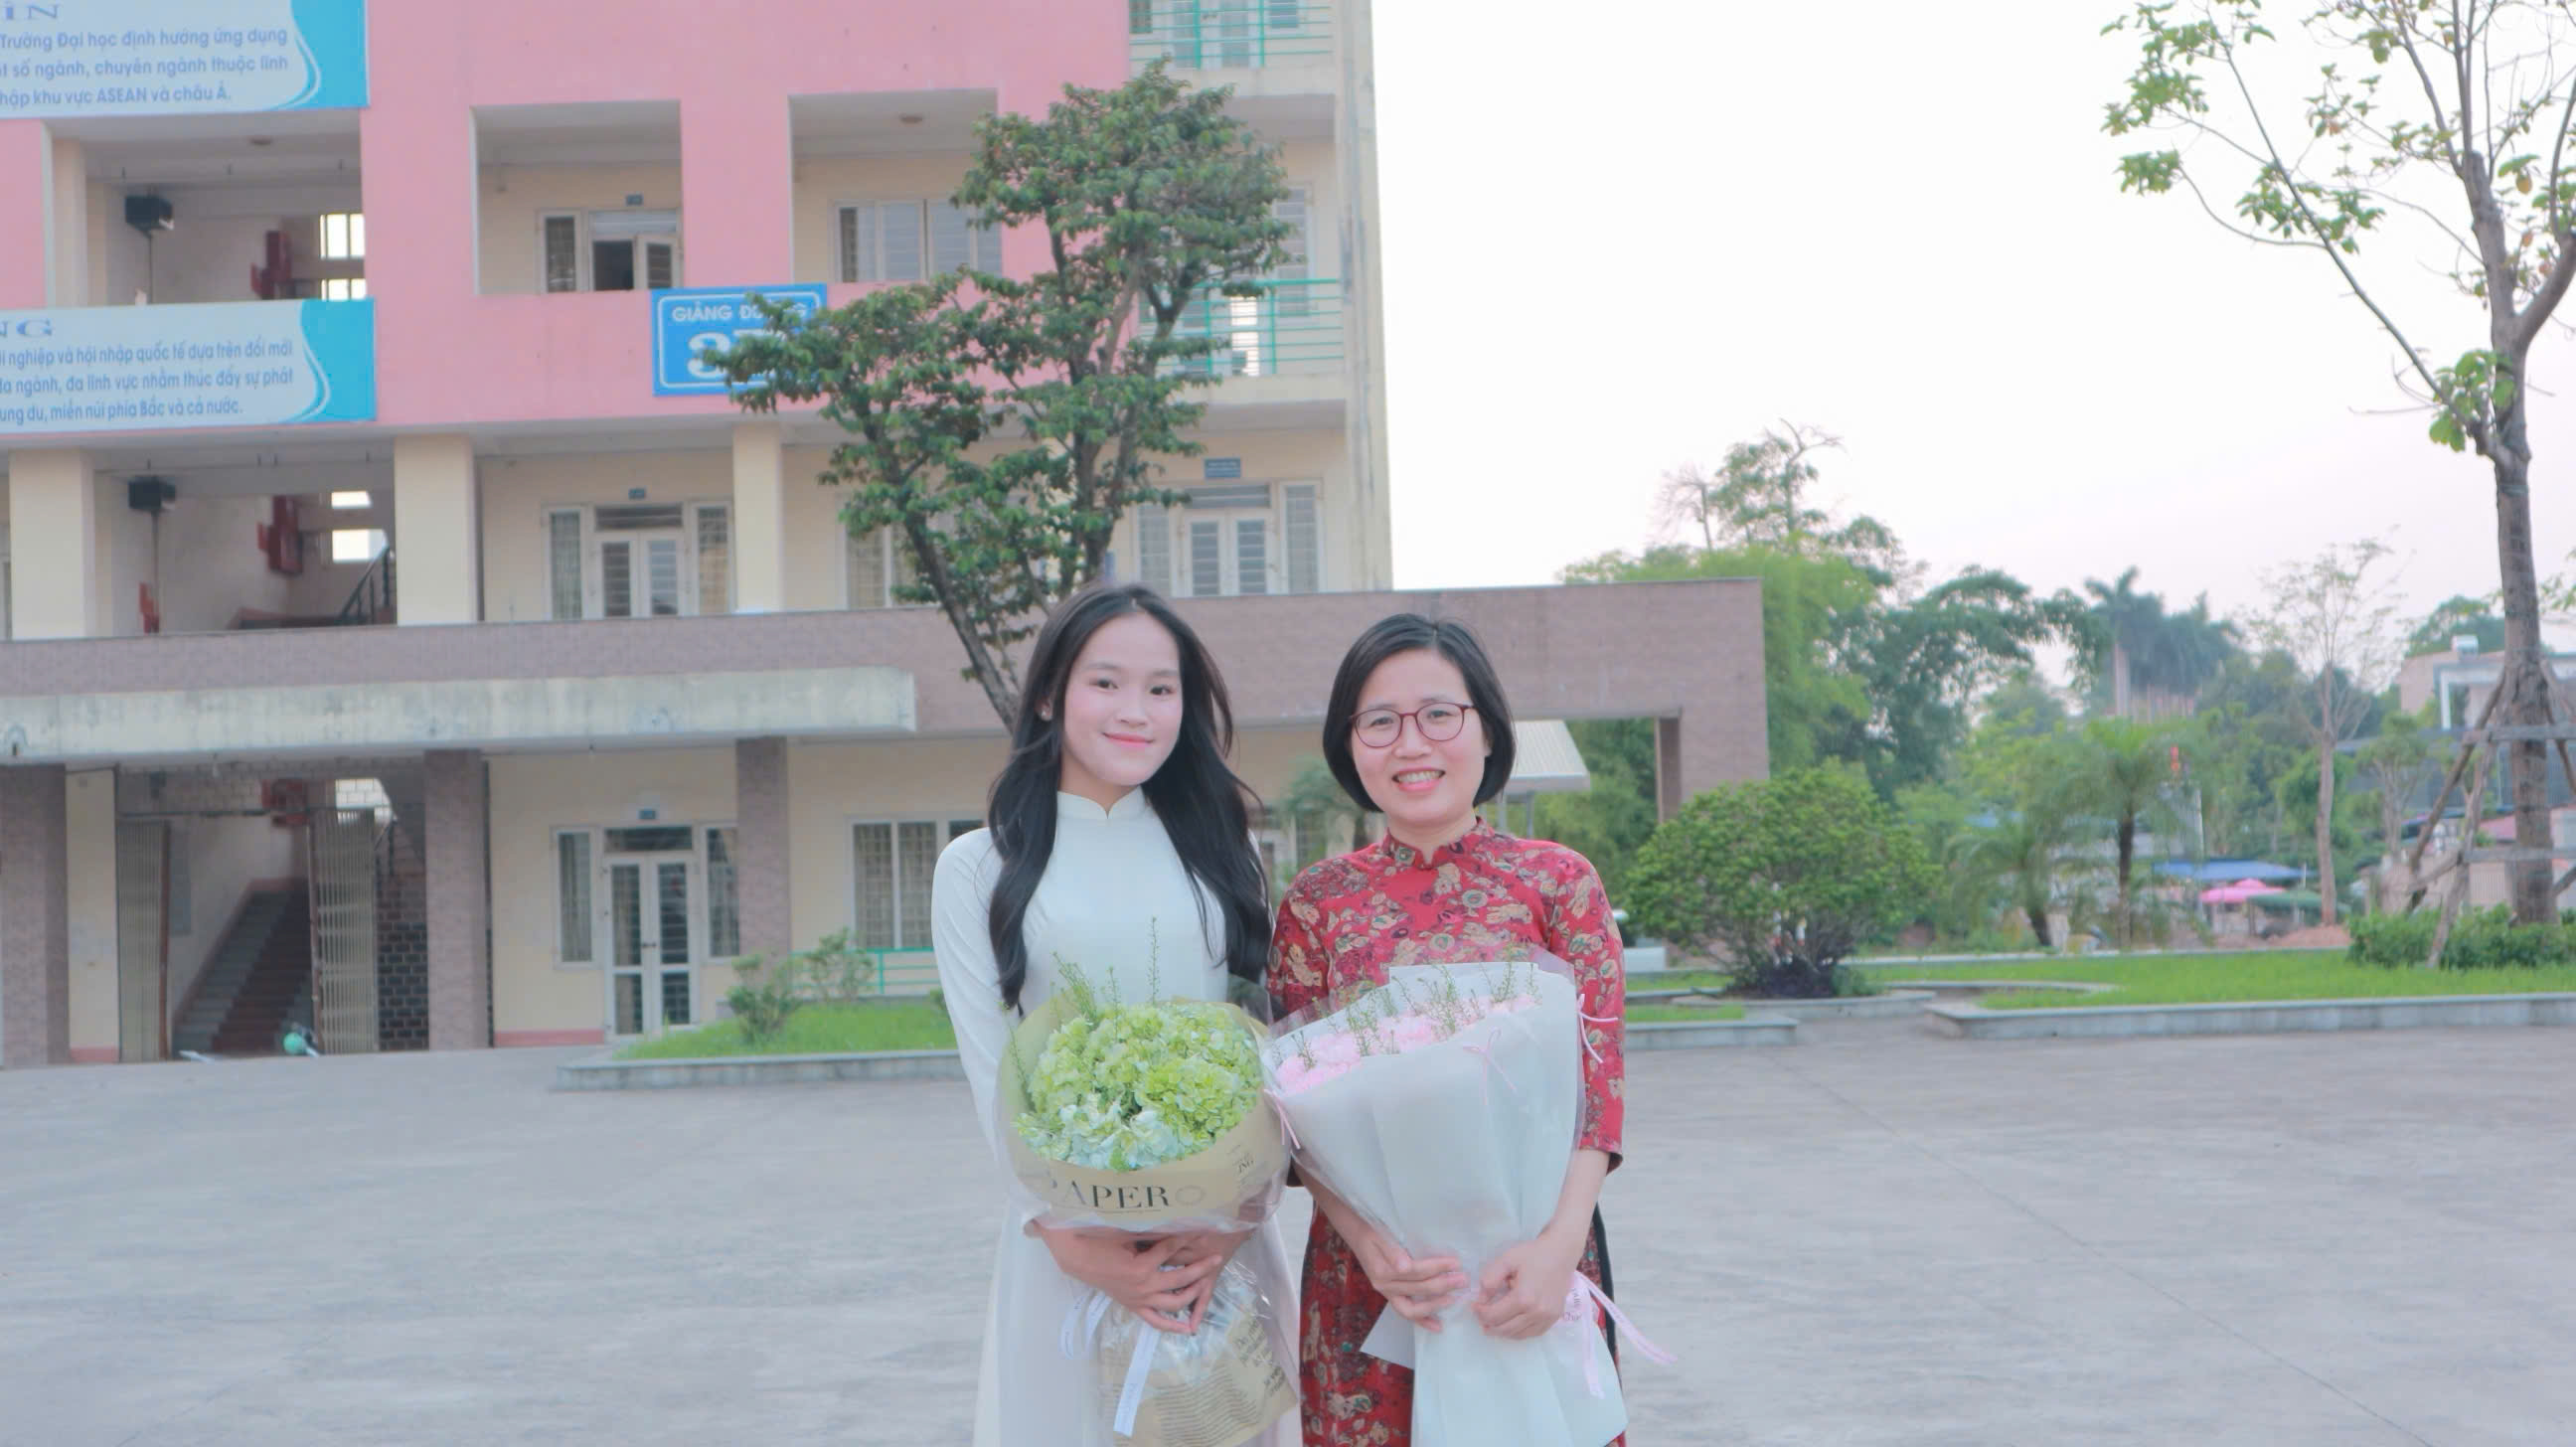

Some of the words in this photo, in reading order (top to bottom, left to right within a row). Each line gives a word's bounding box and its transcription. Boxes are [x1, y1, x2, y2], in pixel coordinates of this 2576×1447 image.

[57, 32, 83, 52] Đại
[87, 32, 117, 52] học
[121, 29, 156, 51] định
[159, 27, 209, 48] hướng
[214, 26, 242, 48] ứng
[247, 28, 287, 48] dụng
[12, 58, 31, 78] số
[35, 59, 90, 81] ngành,
[94, 57, 152, 78] chuyên
[157, 57, 207, 78] ngành
[212, 55, 255, 76] thuộc
[260, 55, 287, 72] lĩnh
[33, 88, 62, 104] khu
[65, 90, 92, 108] vực
[96, 86, 147, 103] ASEAN
[151, 83, 170, 101] và
[173, 82, 214, 101] châu
[672, 301, 732, 322] GIẢNG
[8, 347, 55, 370] nghiệp
[57, 345, 74, 364] và
[77, 344, 96, 367] hội
[99, 343, 133, 366] nhập
[135, 339, 169, 364] quốc
[172, 339, 187, 359] tế
[189, 343, 214, 362] dựa
[216, 340, 242, 358] trên
[268, 336, 293, 357] mới
[16, 374, 62, 398] ngành,
[87, 374, 111, 391] lĩnh
[114, 376, 138, 394] vực
[142, 366, 180, 390] nhằm
[183, 368, 213, 387] thúc
[216, 365, 241, 389] đẩy
[244, 369, 260, 390] sự
[262, 366, 293, 388] phát
[27, 404, 48, 423] du,
[50, 399, 82, 421] miền
[85, 399, 104, 419] núi
[107, 400, 137, 421] phía
[139, 394, 165, 416] Bắc
[167, 397, 184, 415] và
[187, 395, 204, 414] cả
[206, 395, 243, 414] nước.
